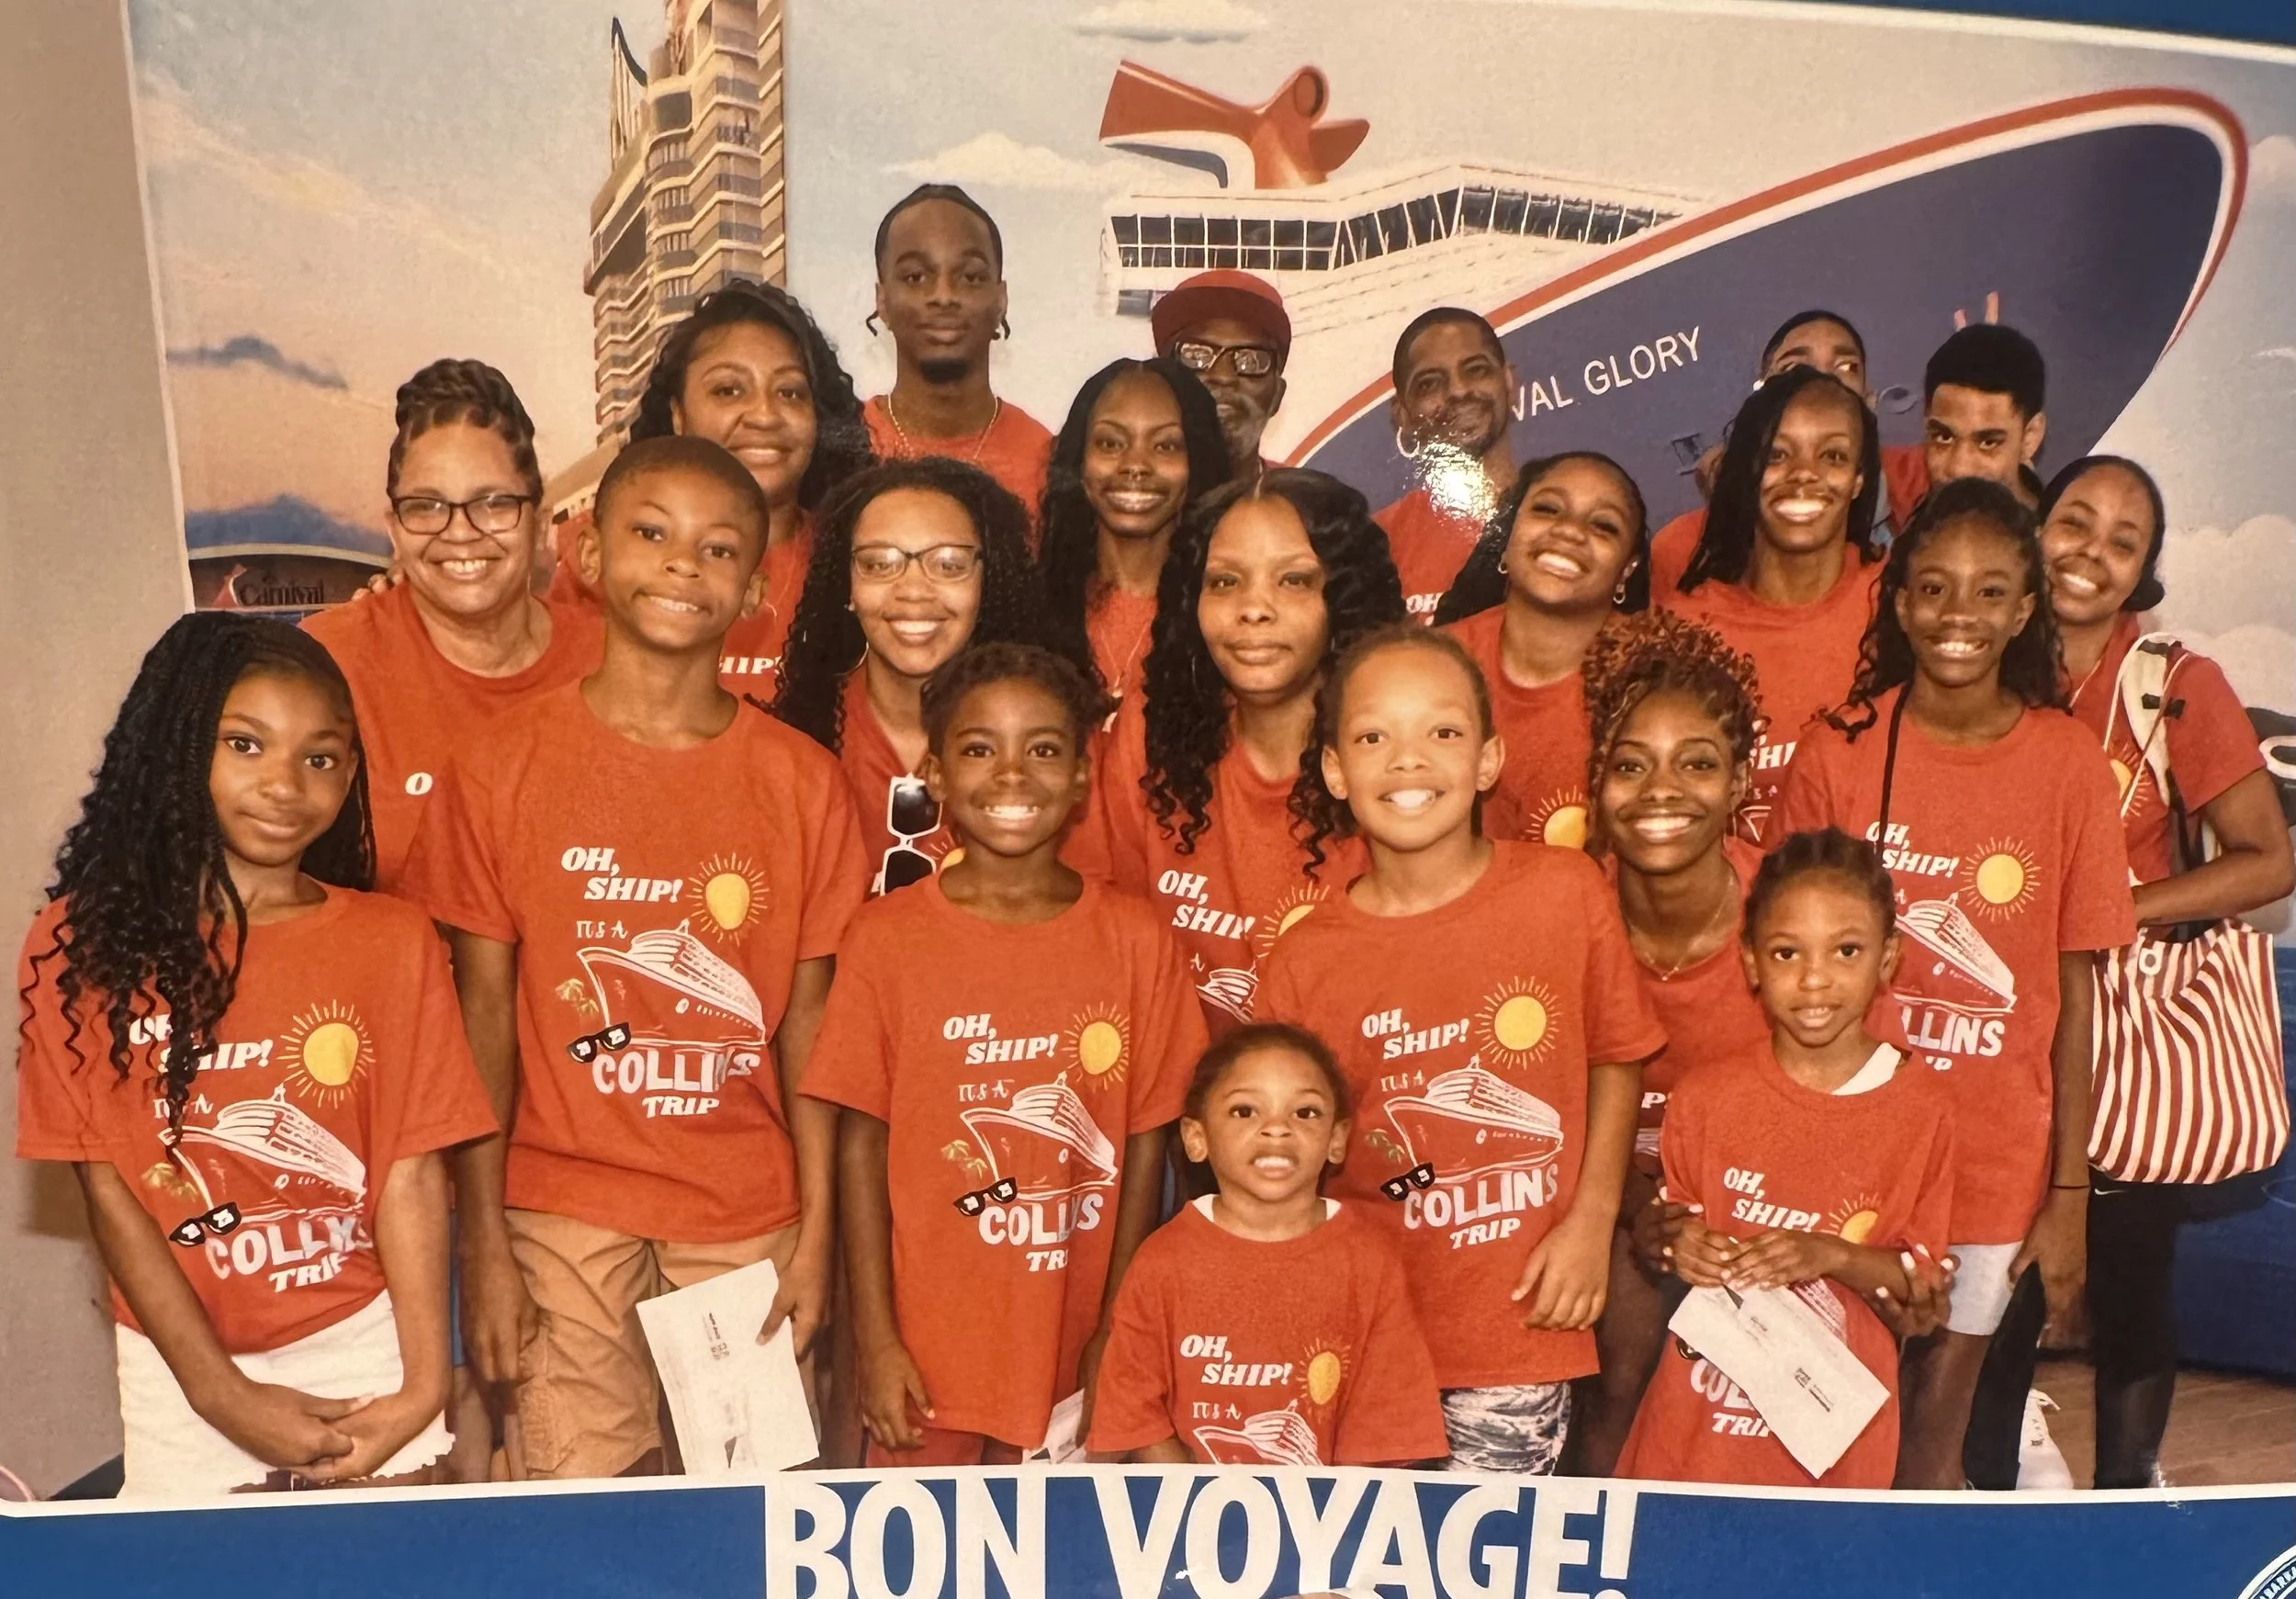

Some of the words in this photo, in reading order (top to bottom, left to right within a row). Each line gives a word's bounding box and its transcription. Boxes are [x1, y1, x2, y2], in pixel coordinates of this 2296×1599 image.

[1583, 325, 1699, 395] GLORY
[560, 846, 620, 876] OH,
[1882, 848, 1960, 878] SHIP!
[583, 877, 683, 904] SHIP!
[1157, 870, 1210, 905] OH,
[610, 919, 629, 940] A
[942, 1013, 997, 1041] OH,
[1361, 1008, 1411, 1036] OH,
[964, 1033, 1059, 1065] SHIP!
[1382, 1018, 1469, 1060] SHIP!
[642, 1096, 719, 1119] TRIP
[1403, 1164, 1559, 1230] COLLINS
[1723, 1166, 1766, 1200] OH,
[1449, 1217, 1521, 1249] TRIP
[1180, 1334, 1232, 1363] OH,
[1200, 1363, 1292, 1387] SHIP!
[765, 1480, 1046, 1599] BON
[1091, 1478, 1638, 1599] VOYAGE!
